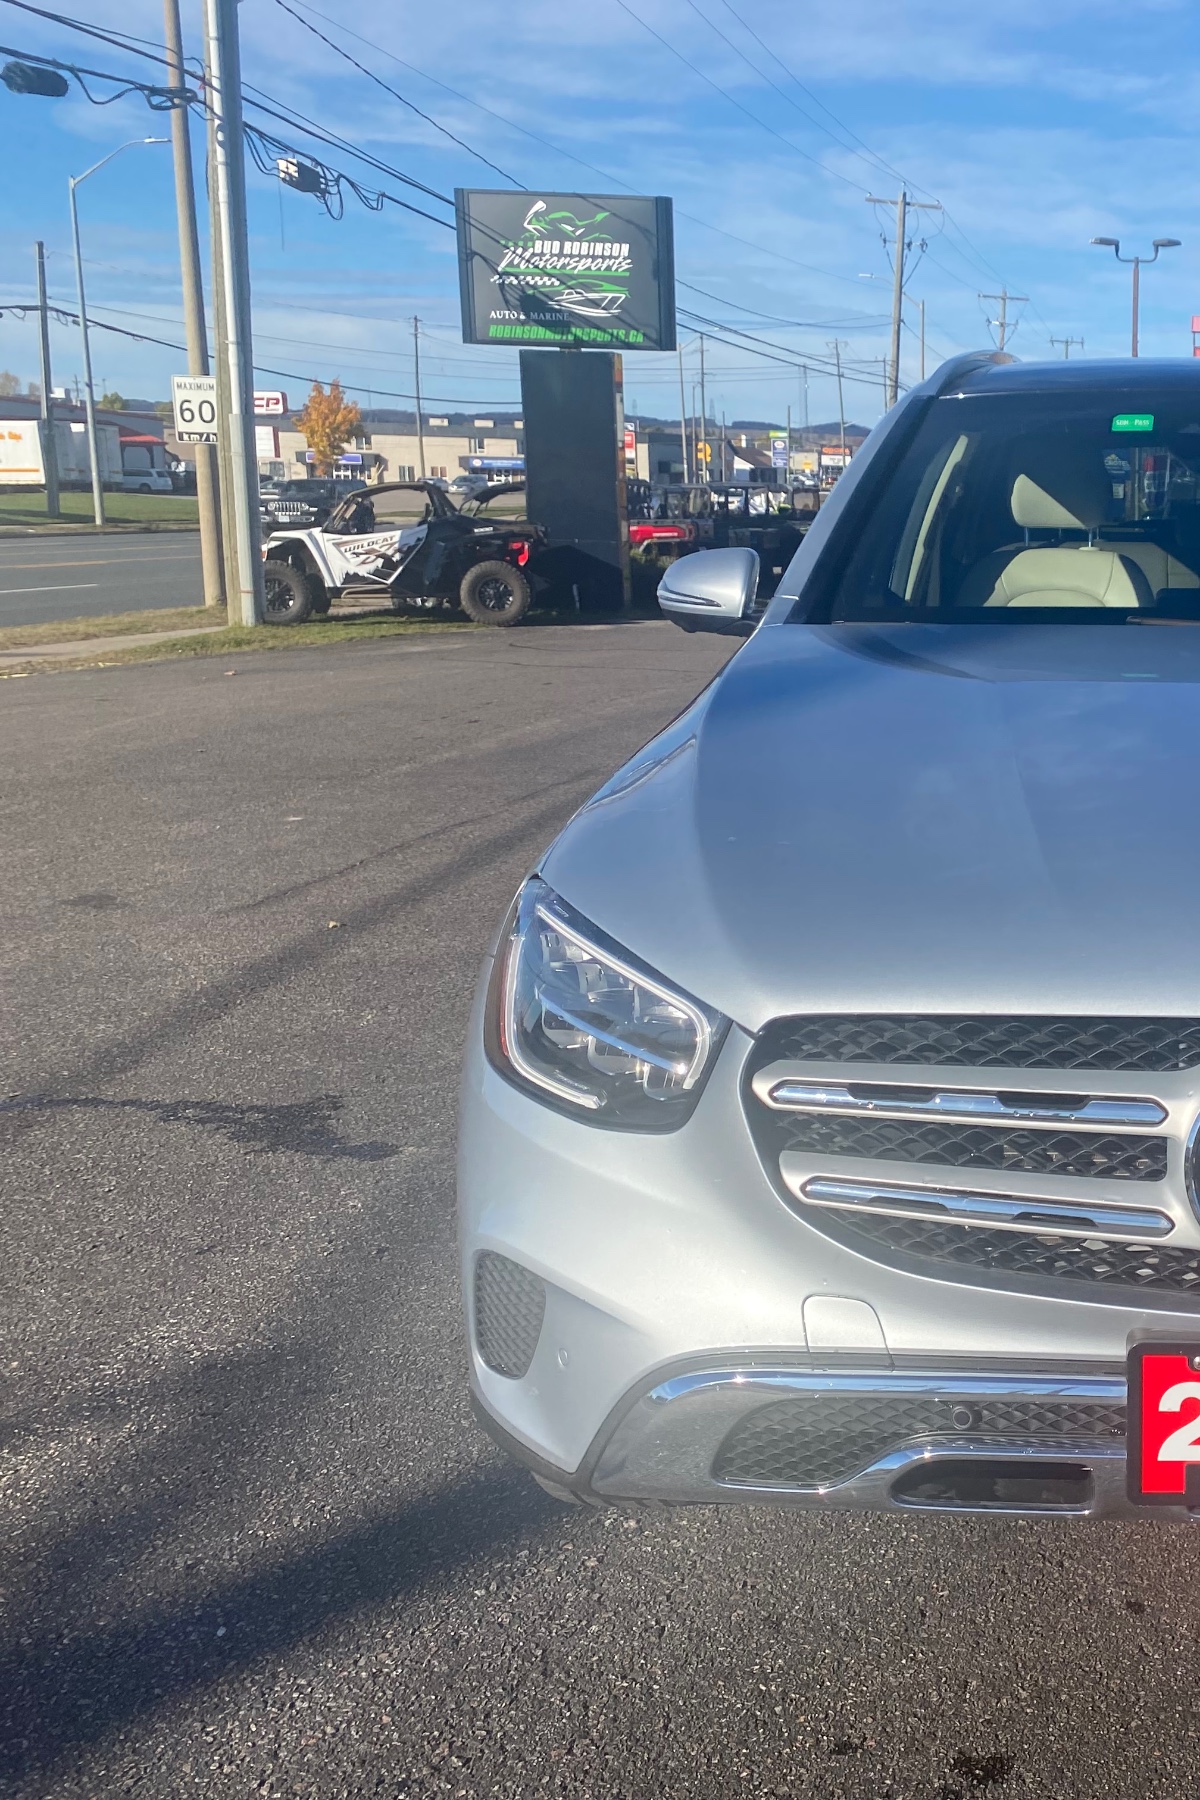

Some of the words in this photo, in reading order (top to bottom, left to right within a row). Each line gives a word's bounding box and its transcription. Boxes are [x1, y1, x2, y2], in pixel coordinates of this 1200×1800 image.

[534, 240, 561, 254] BUD
[563, 241, 630, 257] ROBINSON
[497, 246, 634, 274] Motorsports
[489, 310, 518, 320] AUTO
[519, 311, 527, 320] &
[529, 311, 571, 321] MARINE
[176, 381, 215, 391] MAXIMUM
[179, 399, 216, 424] 60
[182, 432, 217, 442] km/h
[344, 535, 396, 553] WILDCAT
